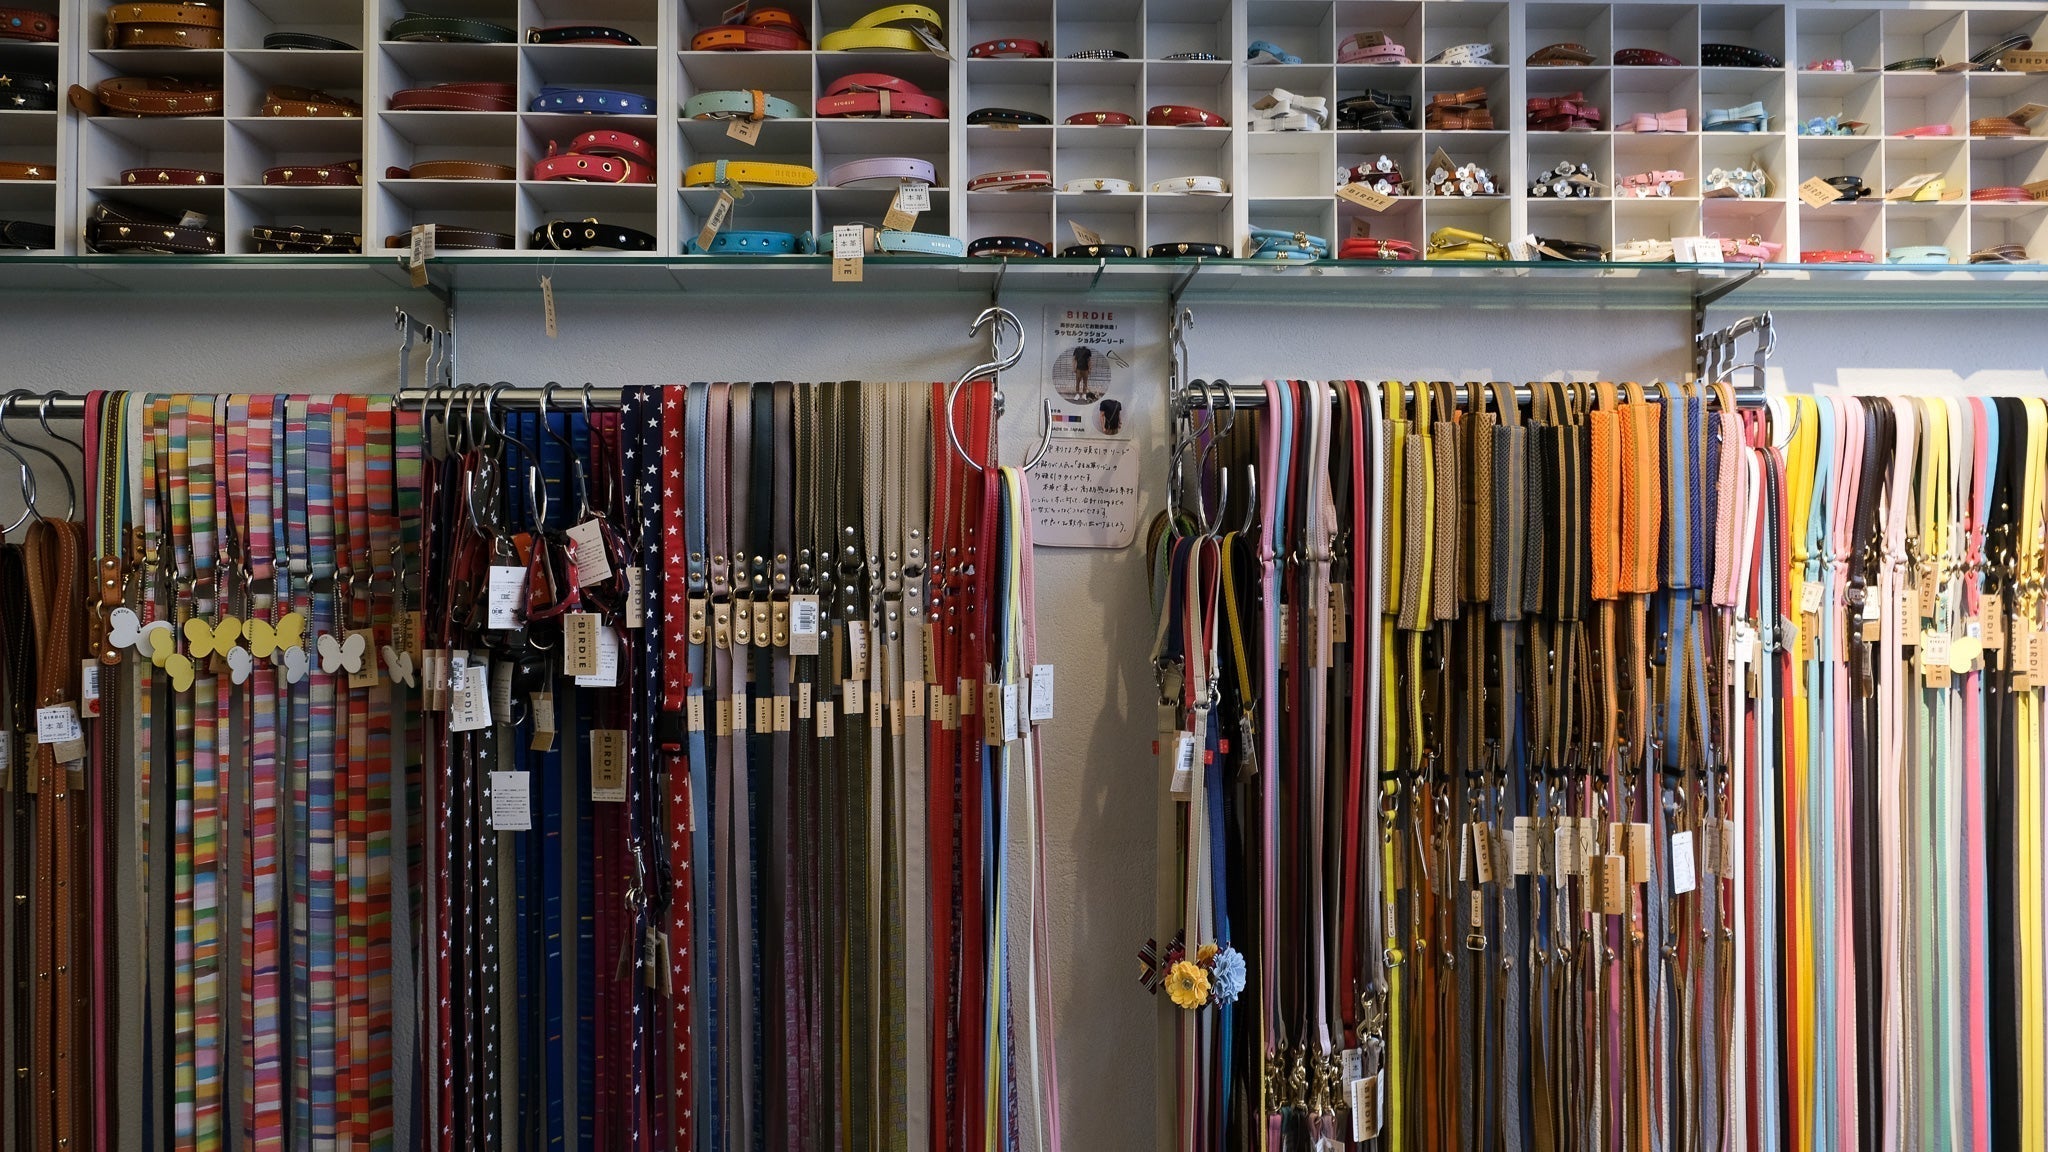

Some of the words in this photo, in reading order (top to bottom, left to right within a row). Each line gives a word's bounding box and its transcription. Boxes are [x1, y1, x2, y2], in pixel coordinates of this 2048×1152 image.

[775, 169, 807, 178] BIRDIE
[1349, 188, 1386, 206] BIRDIE
[1803, 183, 1830, 202] BIRDIE
[1066, 310, 1114, 320] BIRDIE
[1054, 329, 1107, 337] ラッセルクッション
[578, 622, 587, 668] BIRDIE
[858, 628, 867, 673] BIRDIE
[988, 692, 996, 737] BIRDIE
[603, 737, 612, 780] BIRDIE
[1479, 830, 1489, 874] BIRDIE
